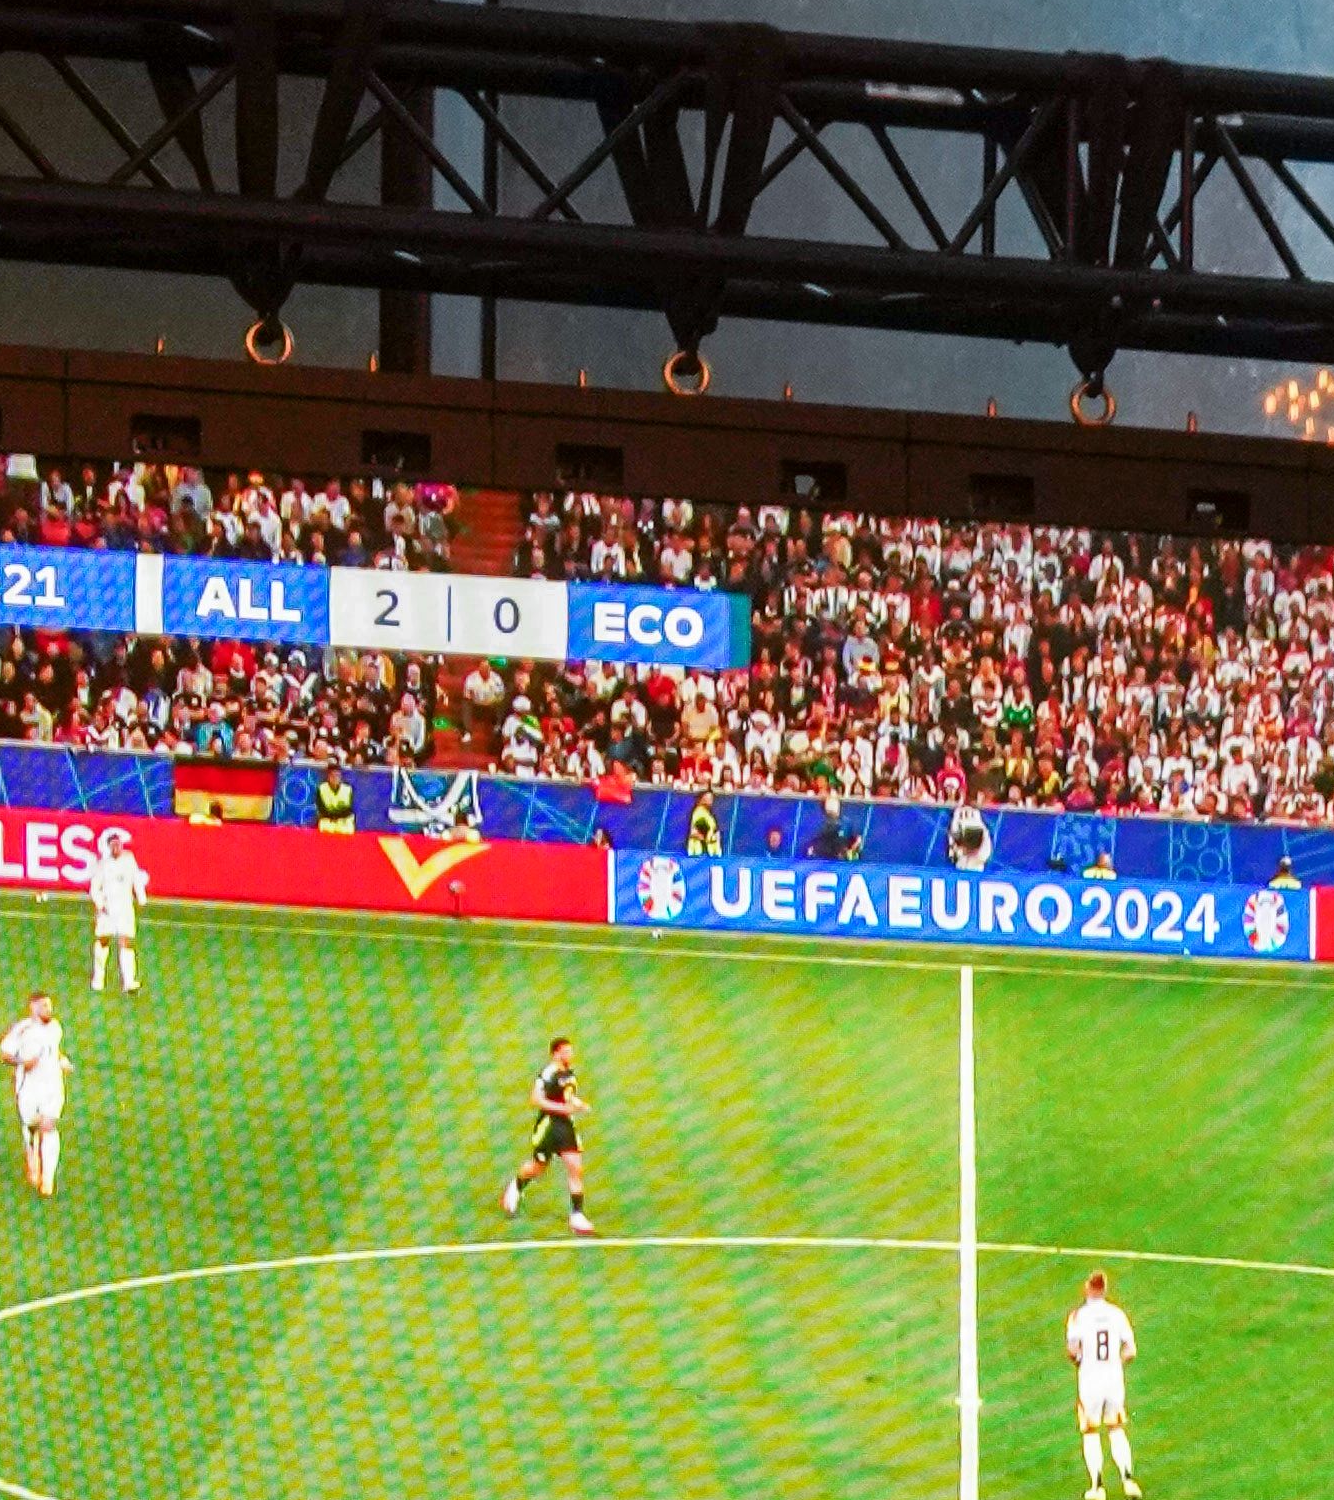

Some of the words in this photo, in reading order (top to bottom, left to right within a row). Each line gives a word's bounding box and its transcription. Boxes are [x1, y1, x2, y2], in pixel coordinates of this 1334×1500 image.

[196, 576, 303, 623] ALL
[373, 589, 400, 627] 2
[493, 597, 521, 634] 0
[593, 602, 704, 647] ECO
[1096, 1330, 1109, 1361] 8
